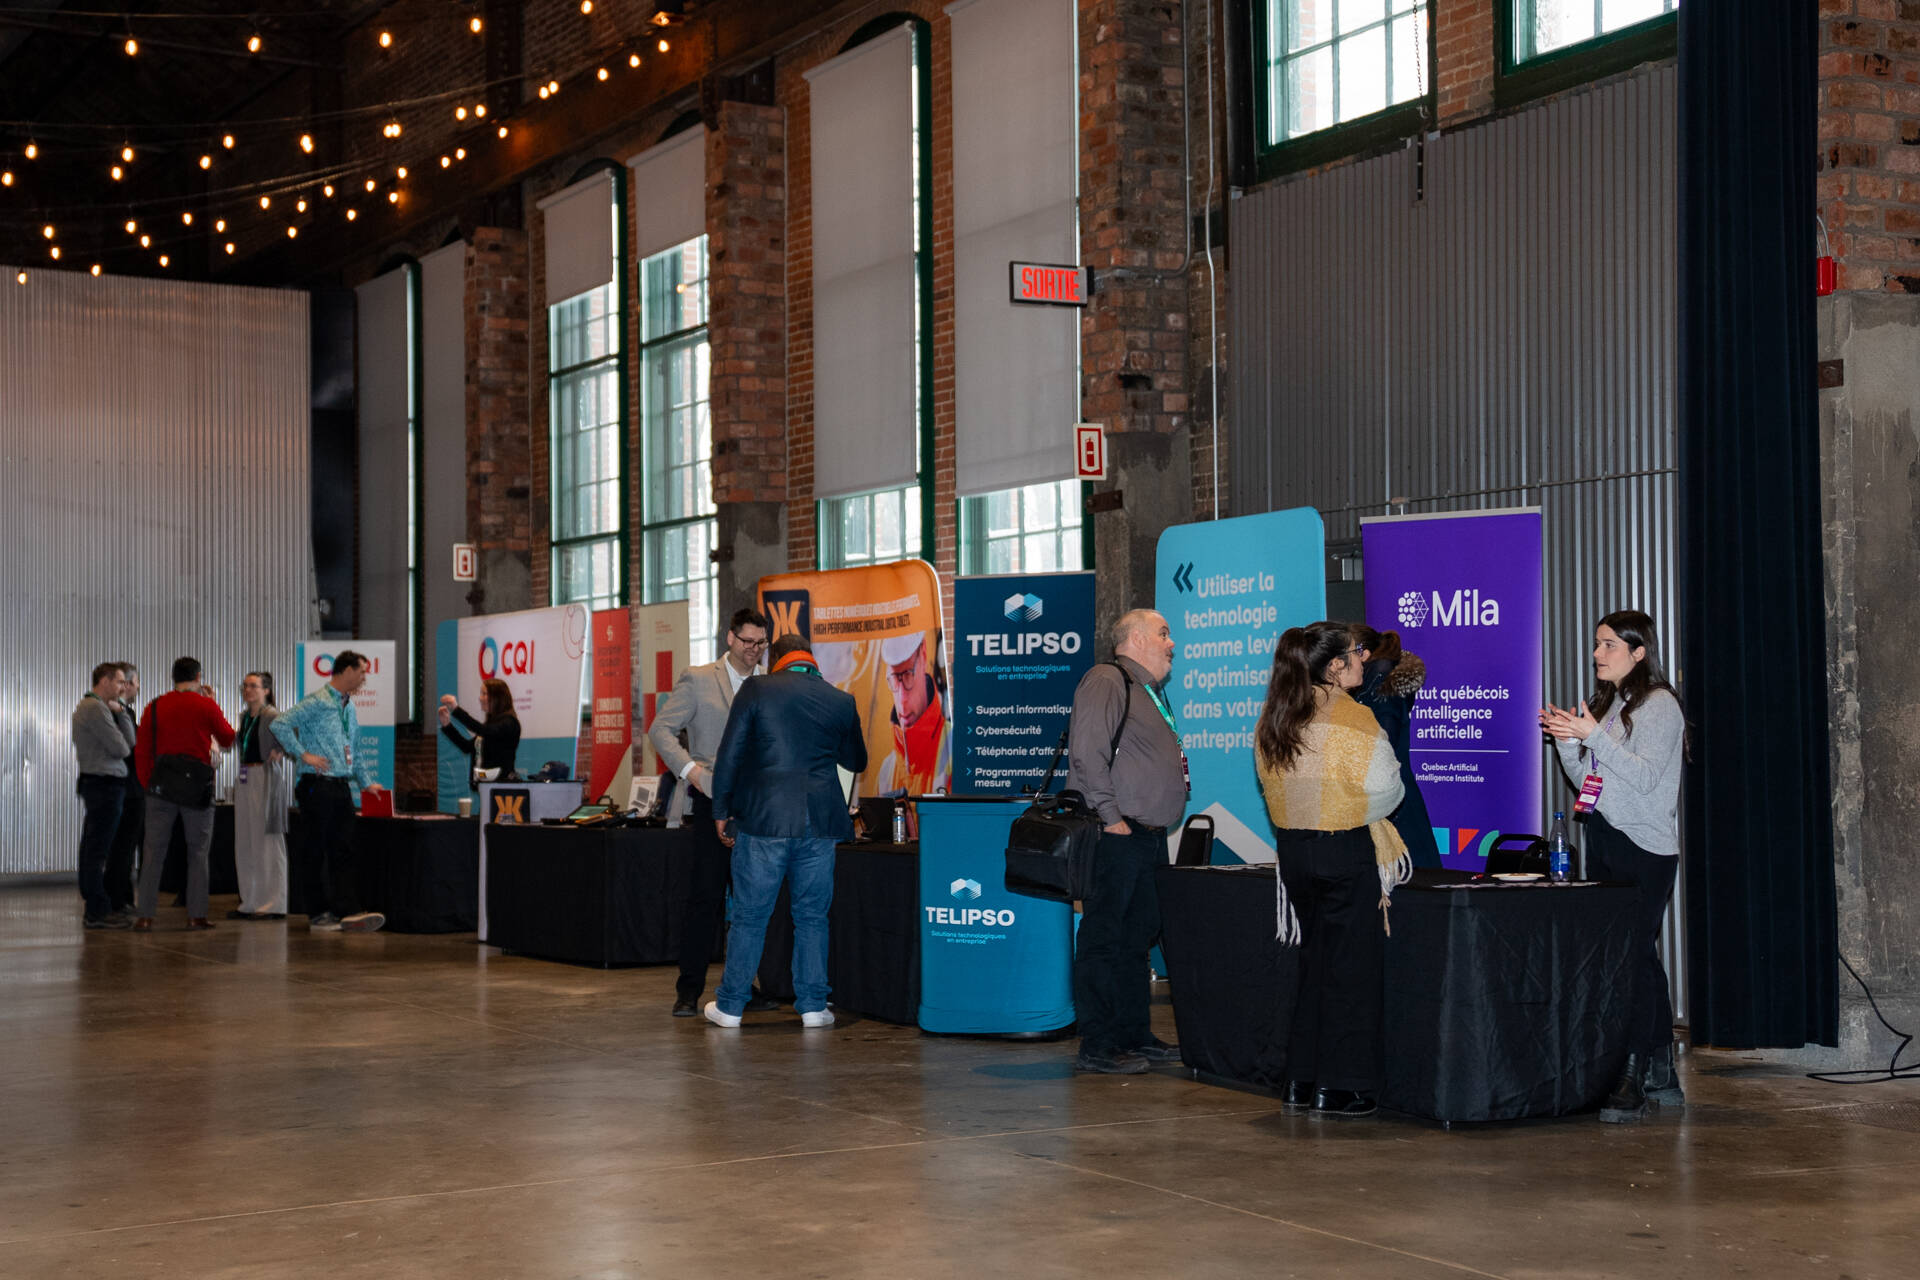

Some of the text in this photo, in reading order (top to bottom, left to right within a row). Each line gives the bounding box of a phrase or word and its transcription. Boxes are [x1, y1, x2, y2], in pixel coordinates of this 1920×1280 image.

[1022, 267, 1080, 301] SORTIE
[1197, 573, 1255, 598] Utiliser
[1258, 571, 1274, 591] la
[1184, 600, 1277, 629] technologie
[1432, 589, 1499, 627] Mila
[814, 623, 827, 635] HIGH
[966, 632, 1082, 656] TELIPSO
[1184, 631, 1278, 659] comme levi
[501, 640, 535, 676] CQI
[976, 664, 1071, 674] Solutions technologiques
[1009, 672, 1048, 681] entreprise
[1184, 664, 1274, 693] d'optimisa
[1440, 685, 1509, 703] québécois
[976, 704, 1072, 716] Support informatiqu
[1183, 699, 1222, 718] dans
[975, 725, 1042, 737] Cybersécurité
[1183, 726, 1255, 754] entrepris
[1416, 725, 1483, 739] artificielle
[975, 746, 1028, 757] Téléphonie
[975, 767, 1047, 779] Programmatio
[1421, 762, 1479, 772] Quebec Artificial
[1415, 773, 1484, 783] Intelligence Institute
[925, 906, 1015, 926] TELIPSO
